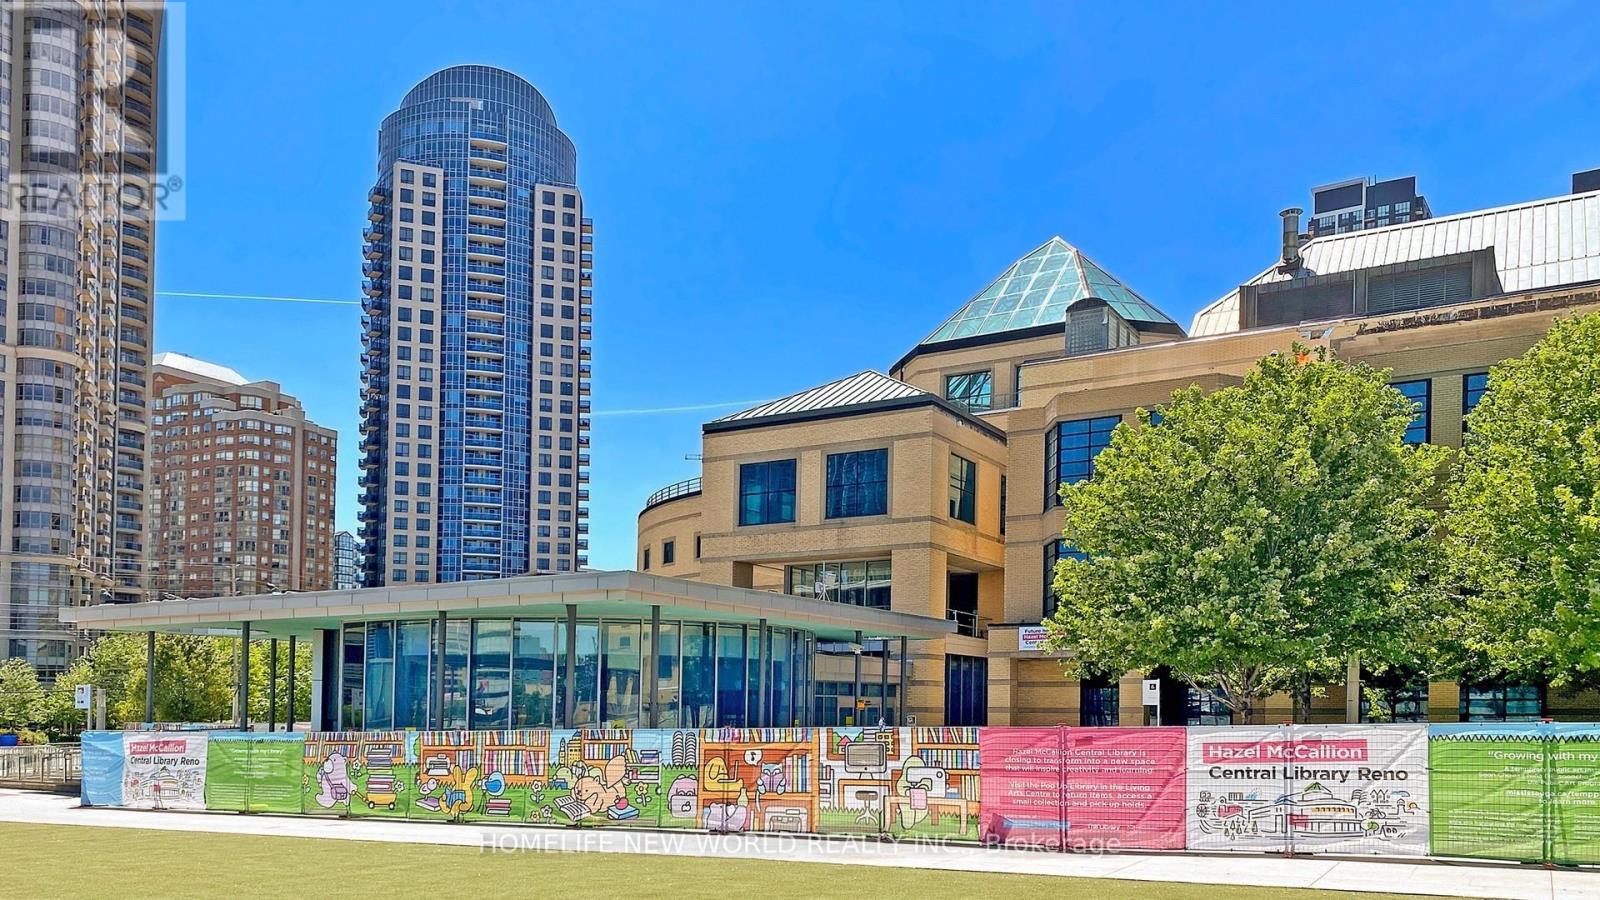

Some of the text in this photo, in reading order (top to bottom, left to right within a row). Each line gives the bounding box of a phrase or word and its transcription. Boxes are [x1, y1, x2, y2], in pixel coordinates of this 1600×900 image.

[131, 742, 185, 753] Hazel McCallion
[1209, 744, 1363, 760] Hazel McCallion
[1074, 748, 1105, 757] Central
[1107, 748, 1137, 758] Library
[1139, 749, 1146, 757] is
[1548, 751, 1575, 761] with
[130, 756, 200, 767] Central Library Reno
[1004, 757, 1032, 765] closing
[1208, 765, 1409, 784] Central Library Reno
[1026, 781, 1040, 789] the
